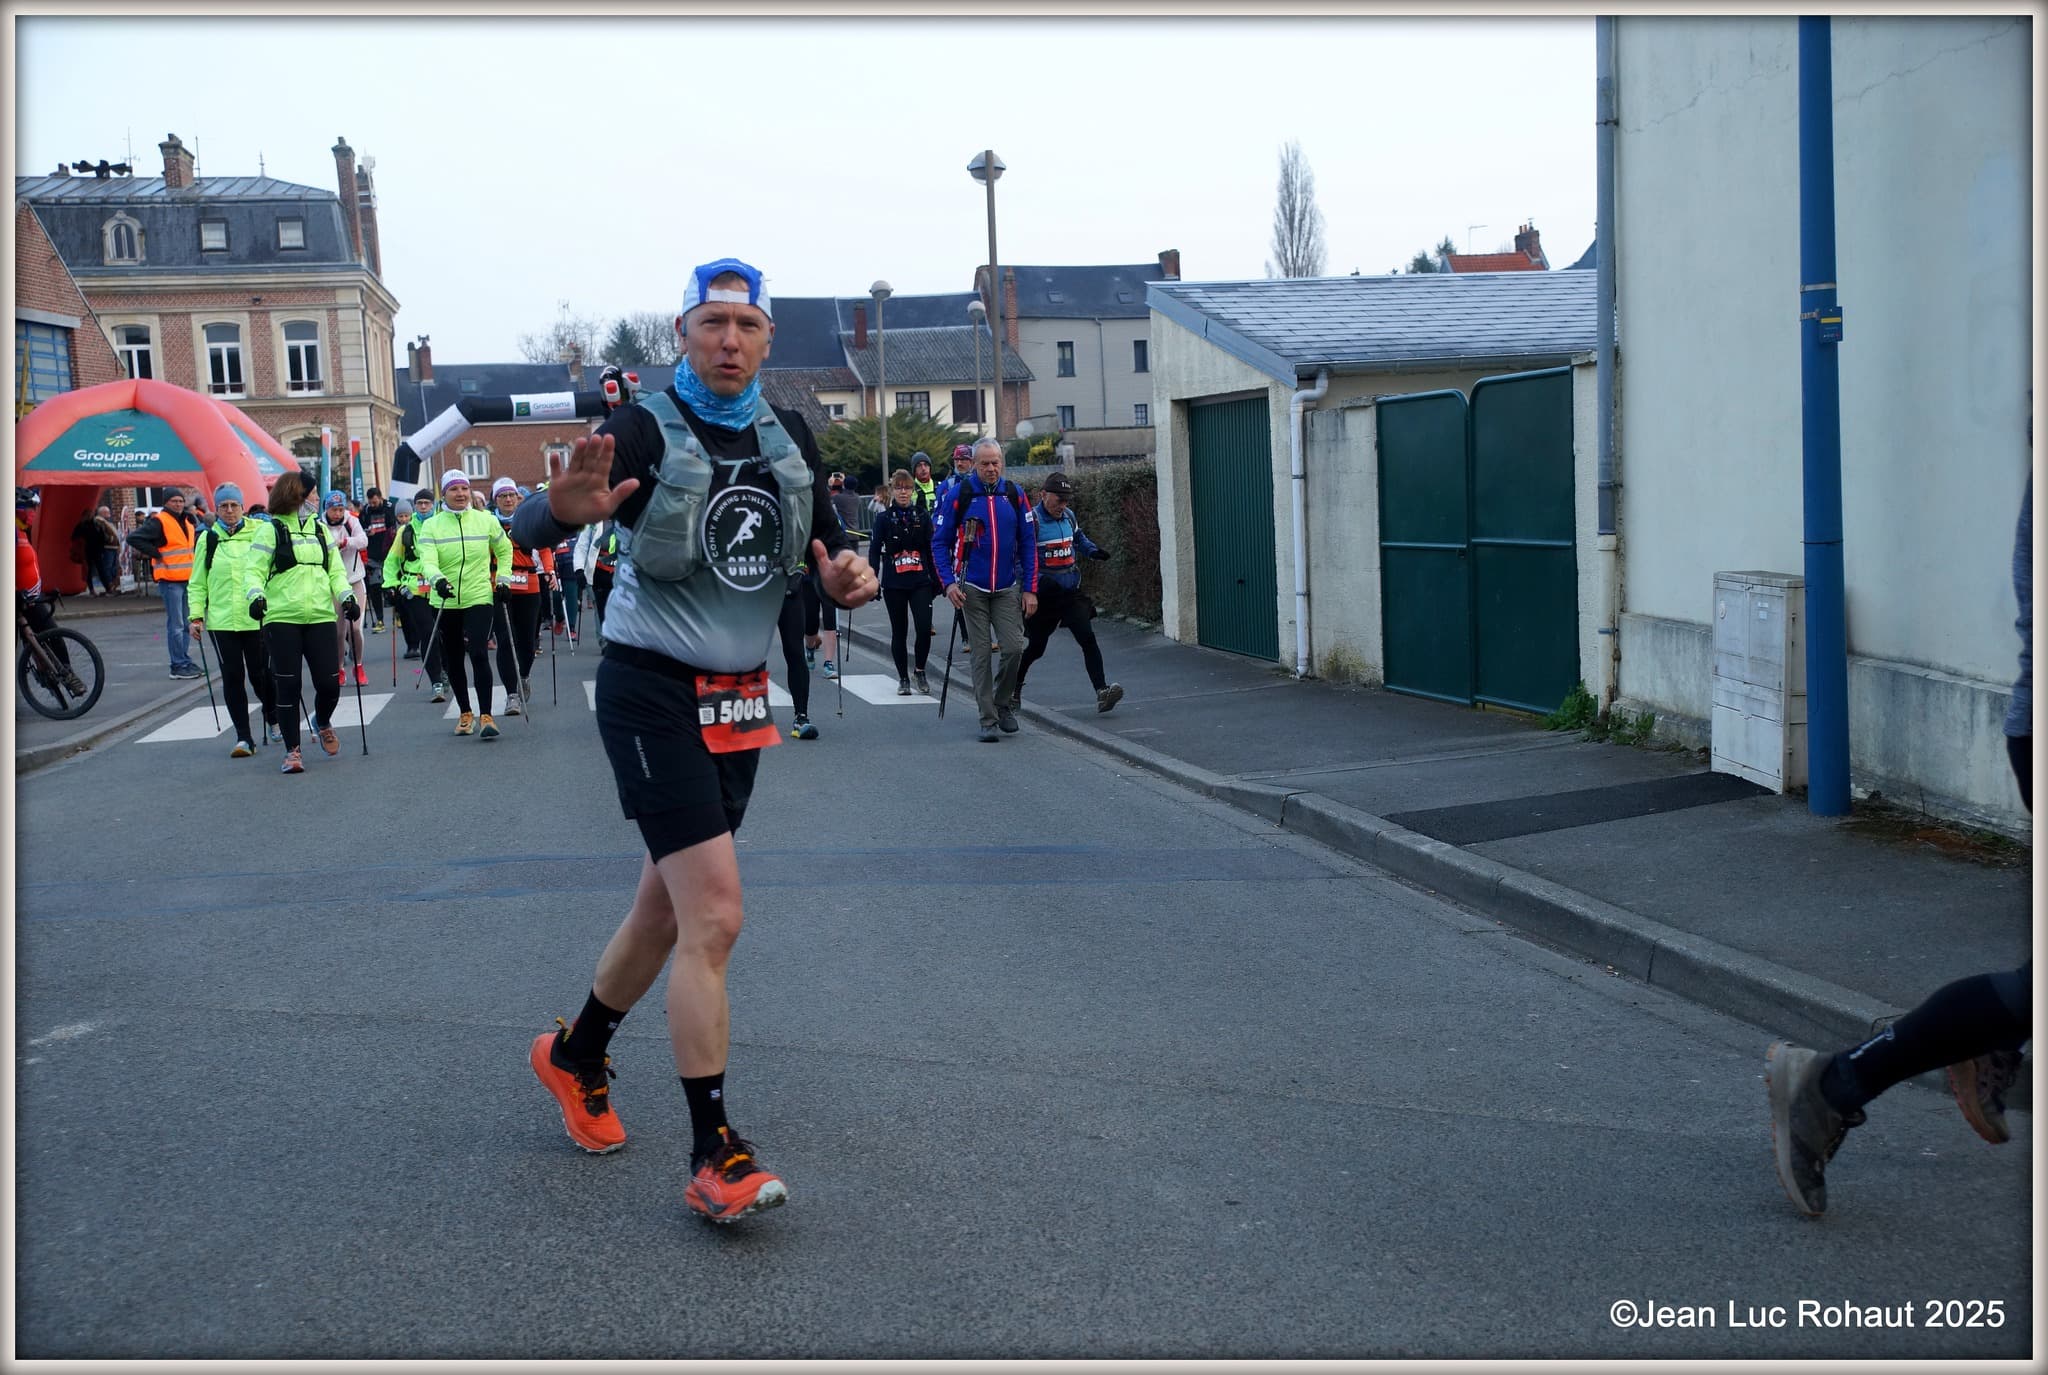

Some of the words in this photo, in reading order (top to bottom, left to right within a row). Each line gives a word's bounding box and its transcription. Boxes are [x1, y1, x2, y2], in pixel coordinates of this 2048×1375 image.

[533, 401, 570, 410] Groupama
[73, 449, 160, 463] Groupama
[712, 494, 740, 522] RUNNING
[773, 529, 781, 554] CLUB
[720, 696, 767, 724] 5008
